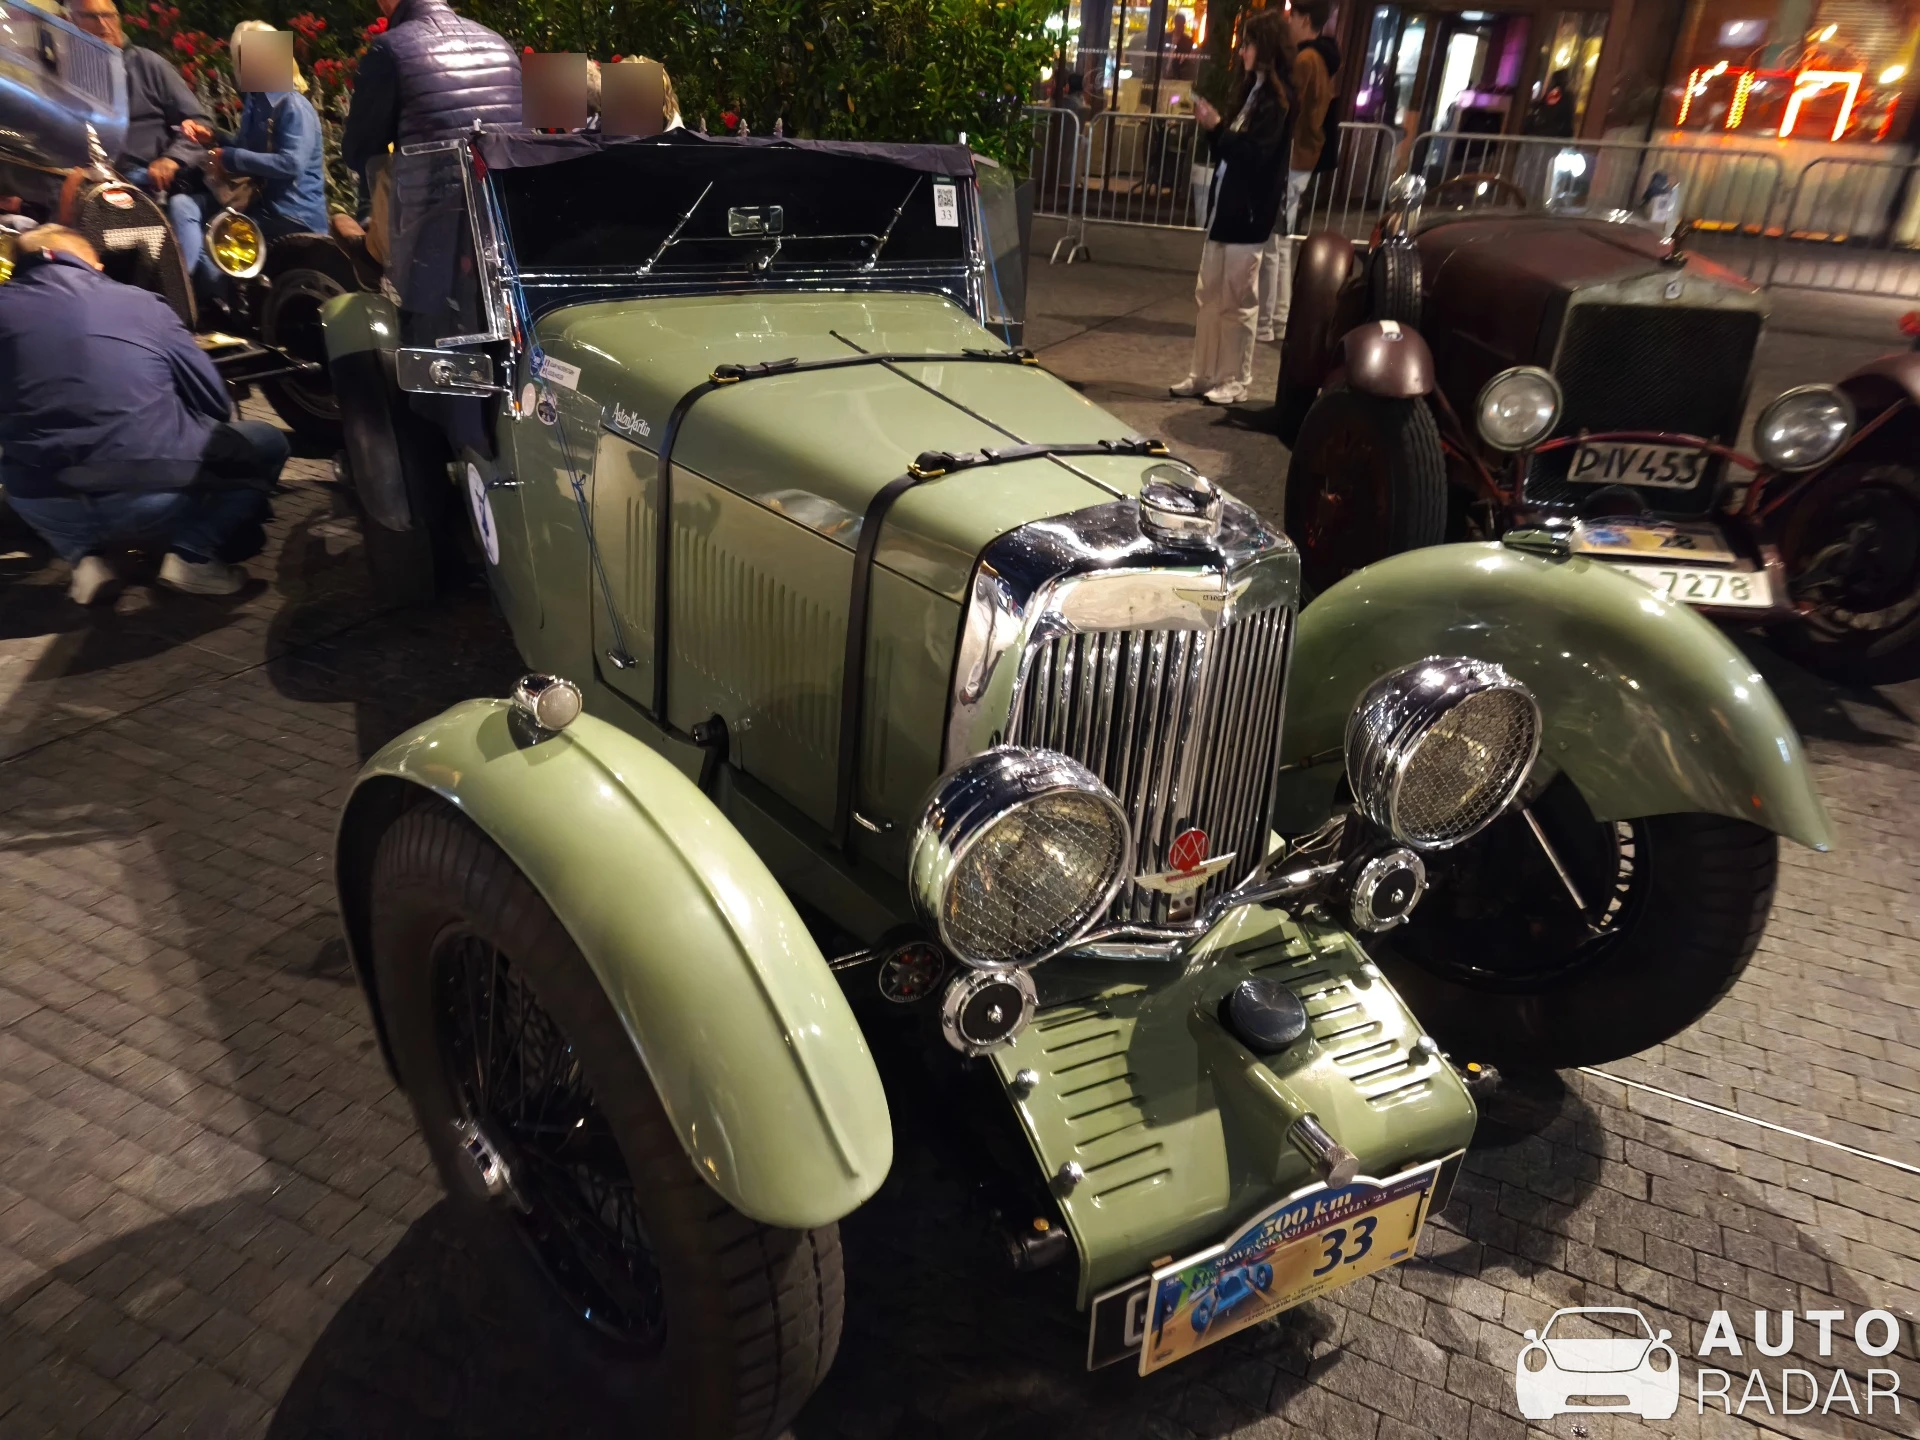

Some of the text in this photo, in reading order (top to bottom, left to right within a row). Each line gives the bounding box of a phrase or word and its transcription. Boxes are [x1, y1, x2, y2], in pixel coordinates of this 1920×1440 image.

[940, 209, 952, 220] 33
[1659, 570, 1752, 602] 7278
[1260, 1192, 1352, 1239] 500 km
[1313, 1215, 1378, 1277] 33
